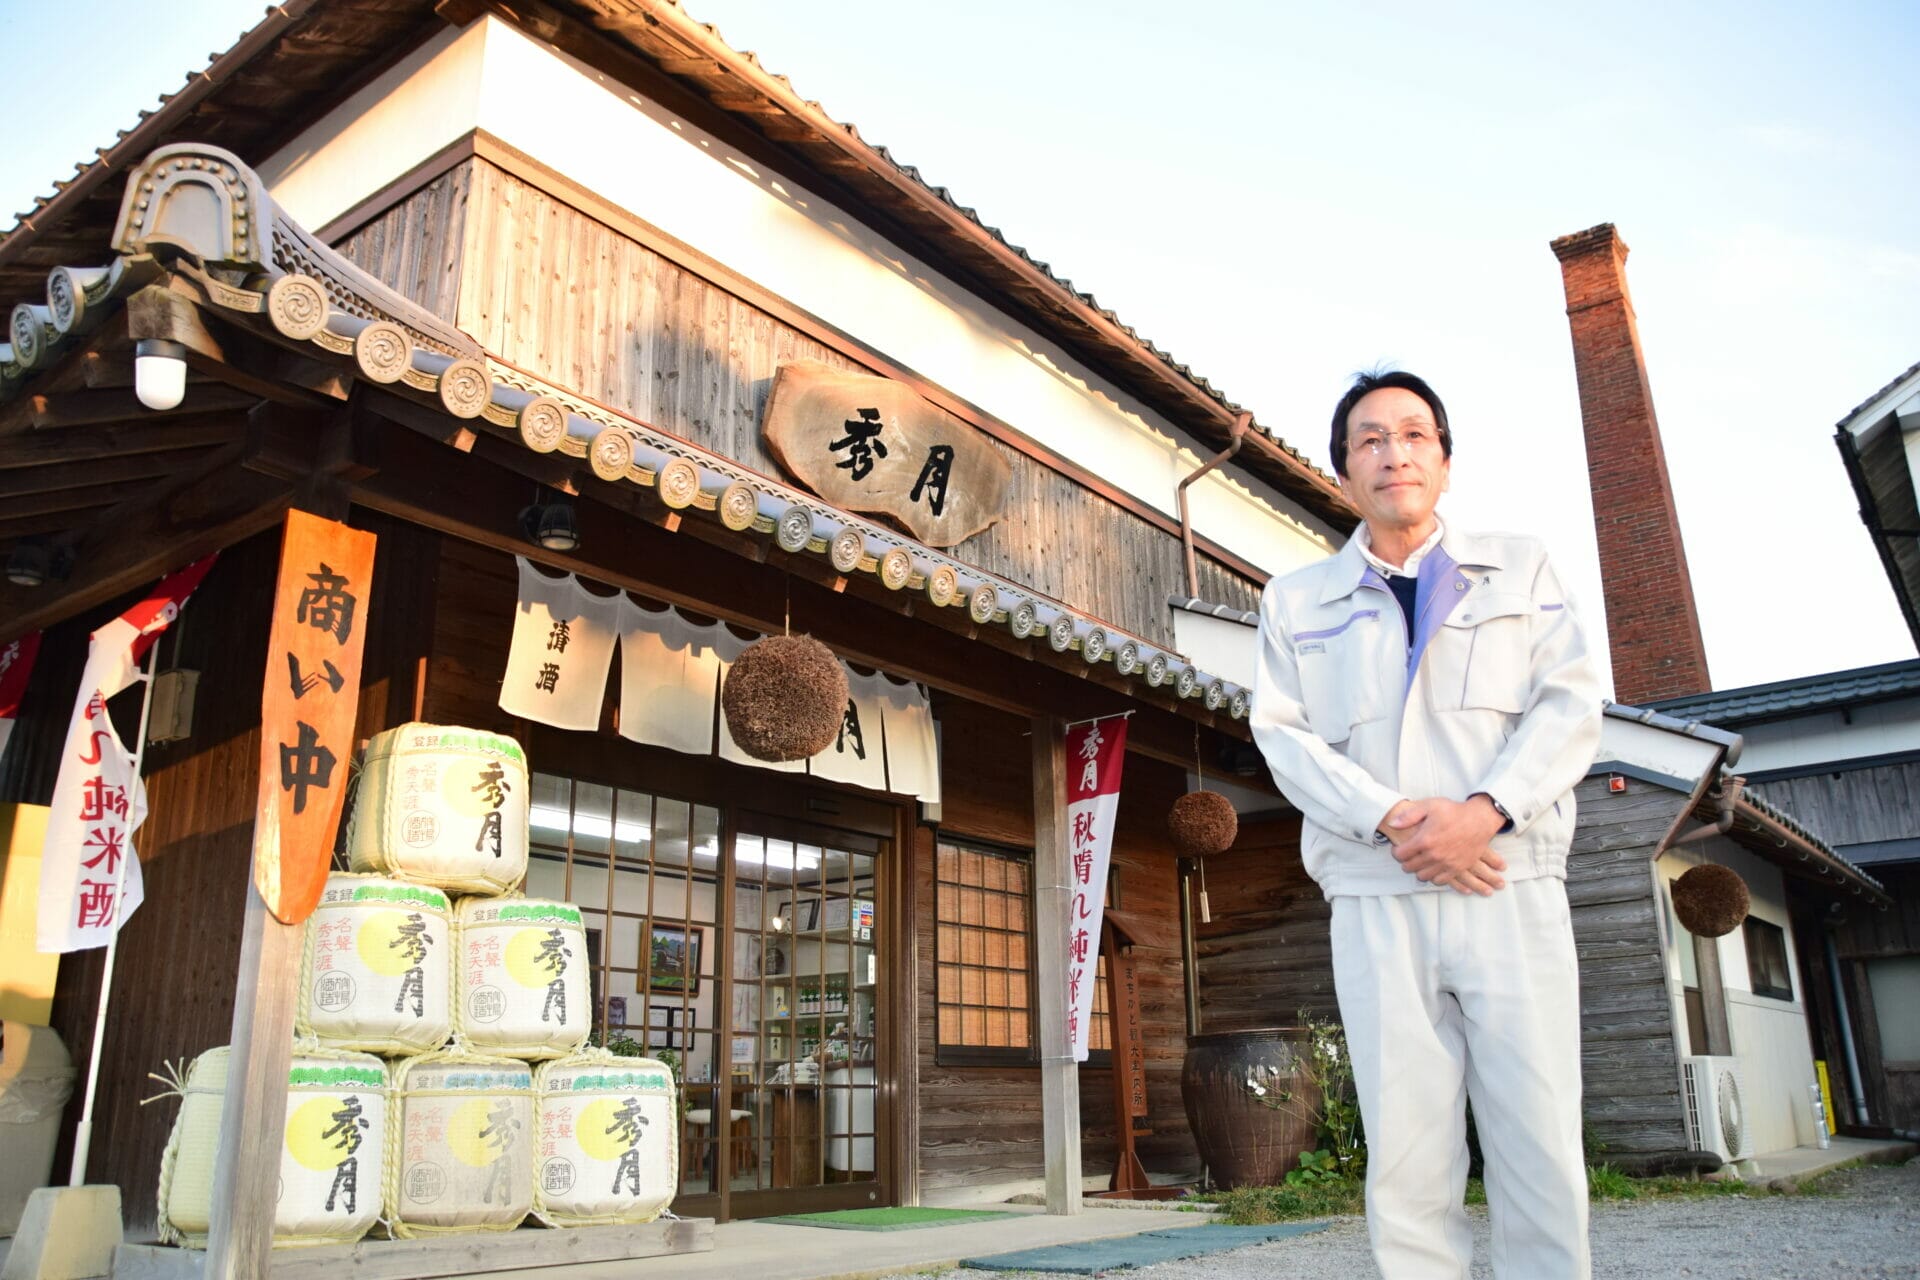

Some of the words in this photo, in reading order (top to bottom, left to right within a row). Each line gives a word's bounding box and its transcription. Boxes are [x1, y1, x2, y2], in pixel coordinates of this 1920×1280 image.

[829, 408, 954, 516] 秀月
[280, 562, 356, 815] 商い中
[535, 619, 570, 694] 清酒
[1079, 727, 1104, 791] 秀月
[389, 913, 434, 1018] 秀月
[533, 928, 573, 1026] 秀月
[322, 1094, 370, 1215] 秀月
[605, 1097, 650, 1197] 秀月
